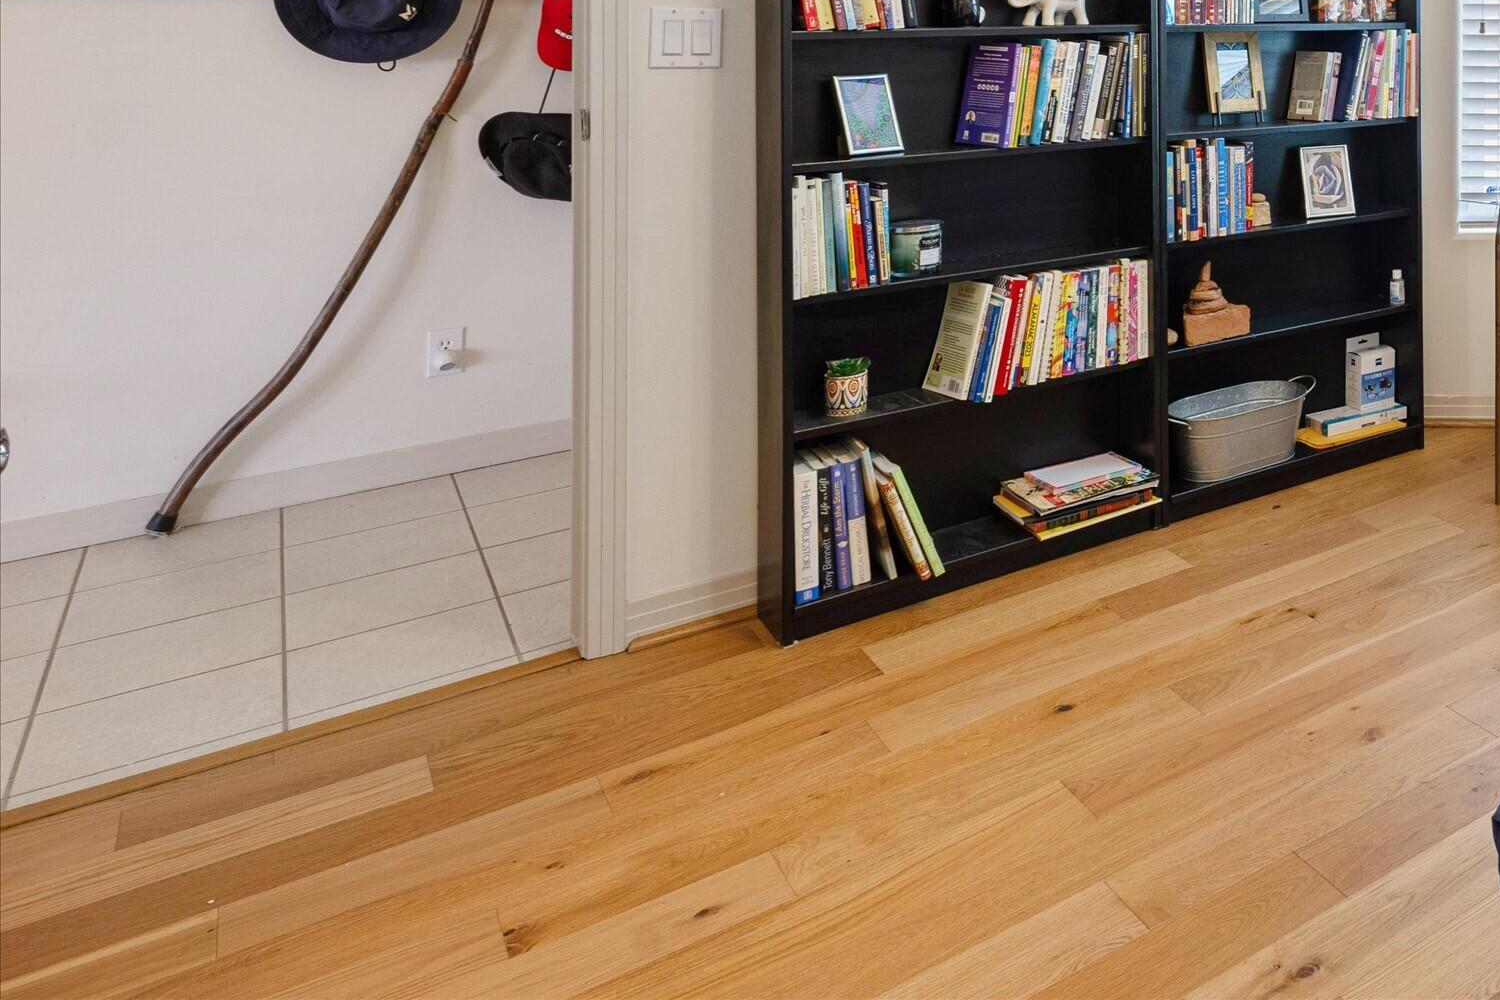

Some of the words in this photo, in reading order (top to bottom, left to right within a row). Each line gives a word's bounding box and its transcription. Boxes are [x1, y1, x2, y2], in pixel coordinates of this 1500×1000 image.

[1027, 303, 1039, 340] ALMANAC
[1025, 341, 1033, 358] 2023
[819, 478, 828, 492] Gift
[833, 482, 841, 504] Storm
[801, 490, 812, 519] HERBAL
[820, 502, 830, 515] Life
[834, 506, 842, 517] the
[835, 518, 843, 531] Am
[801, 520, 812, 571] DRUGSTORE
[855, 530, 864, 554] MEDIUM
[822, 538, 832, 569] Bennett
[824, 571, 834, 589] Tony
[857, 556, 865, 582] MEDICAL
